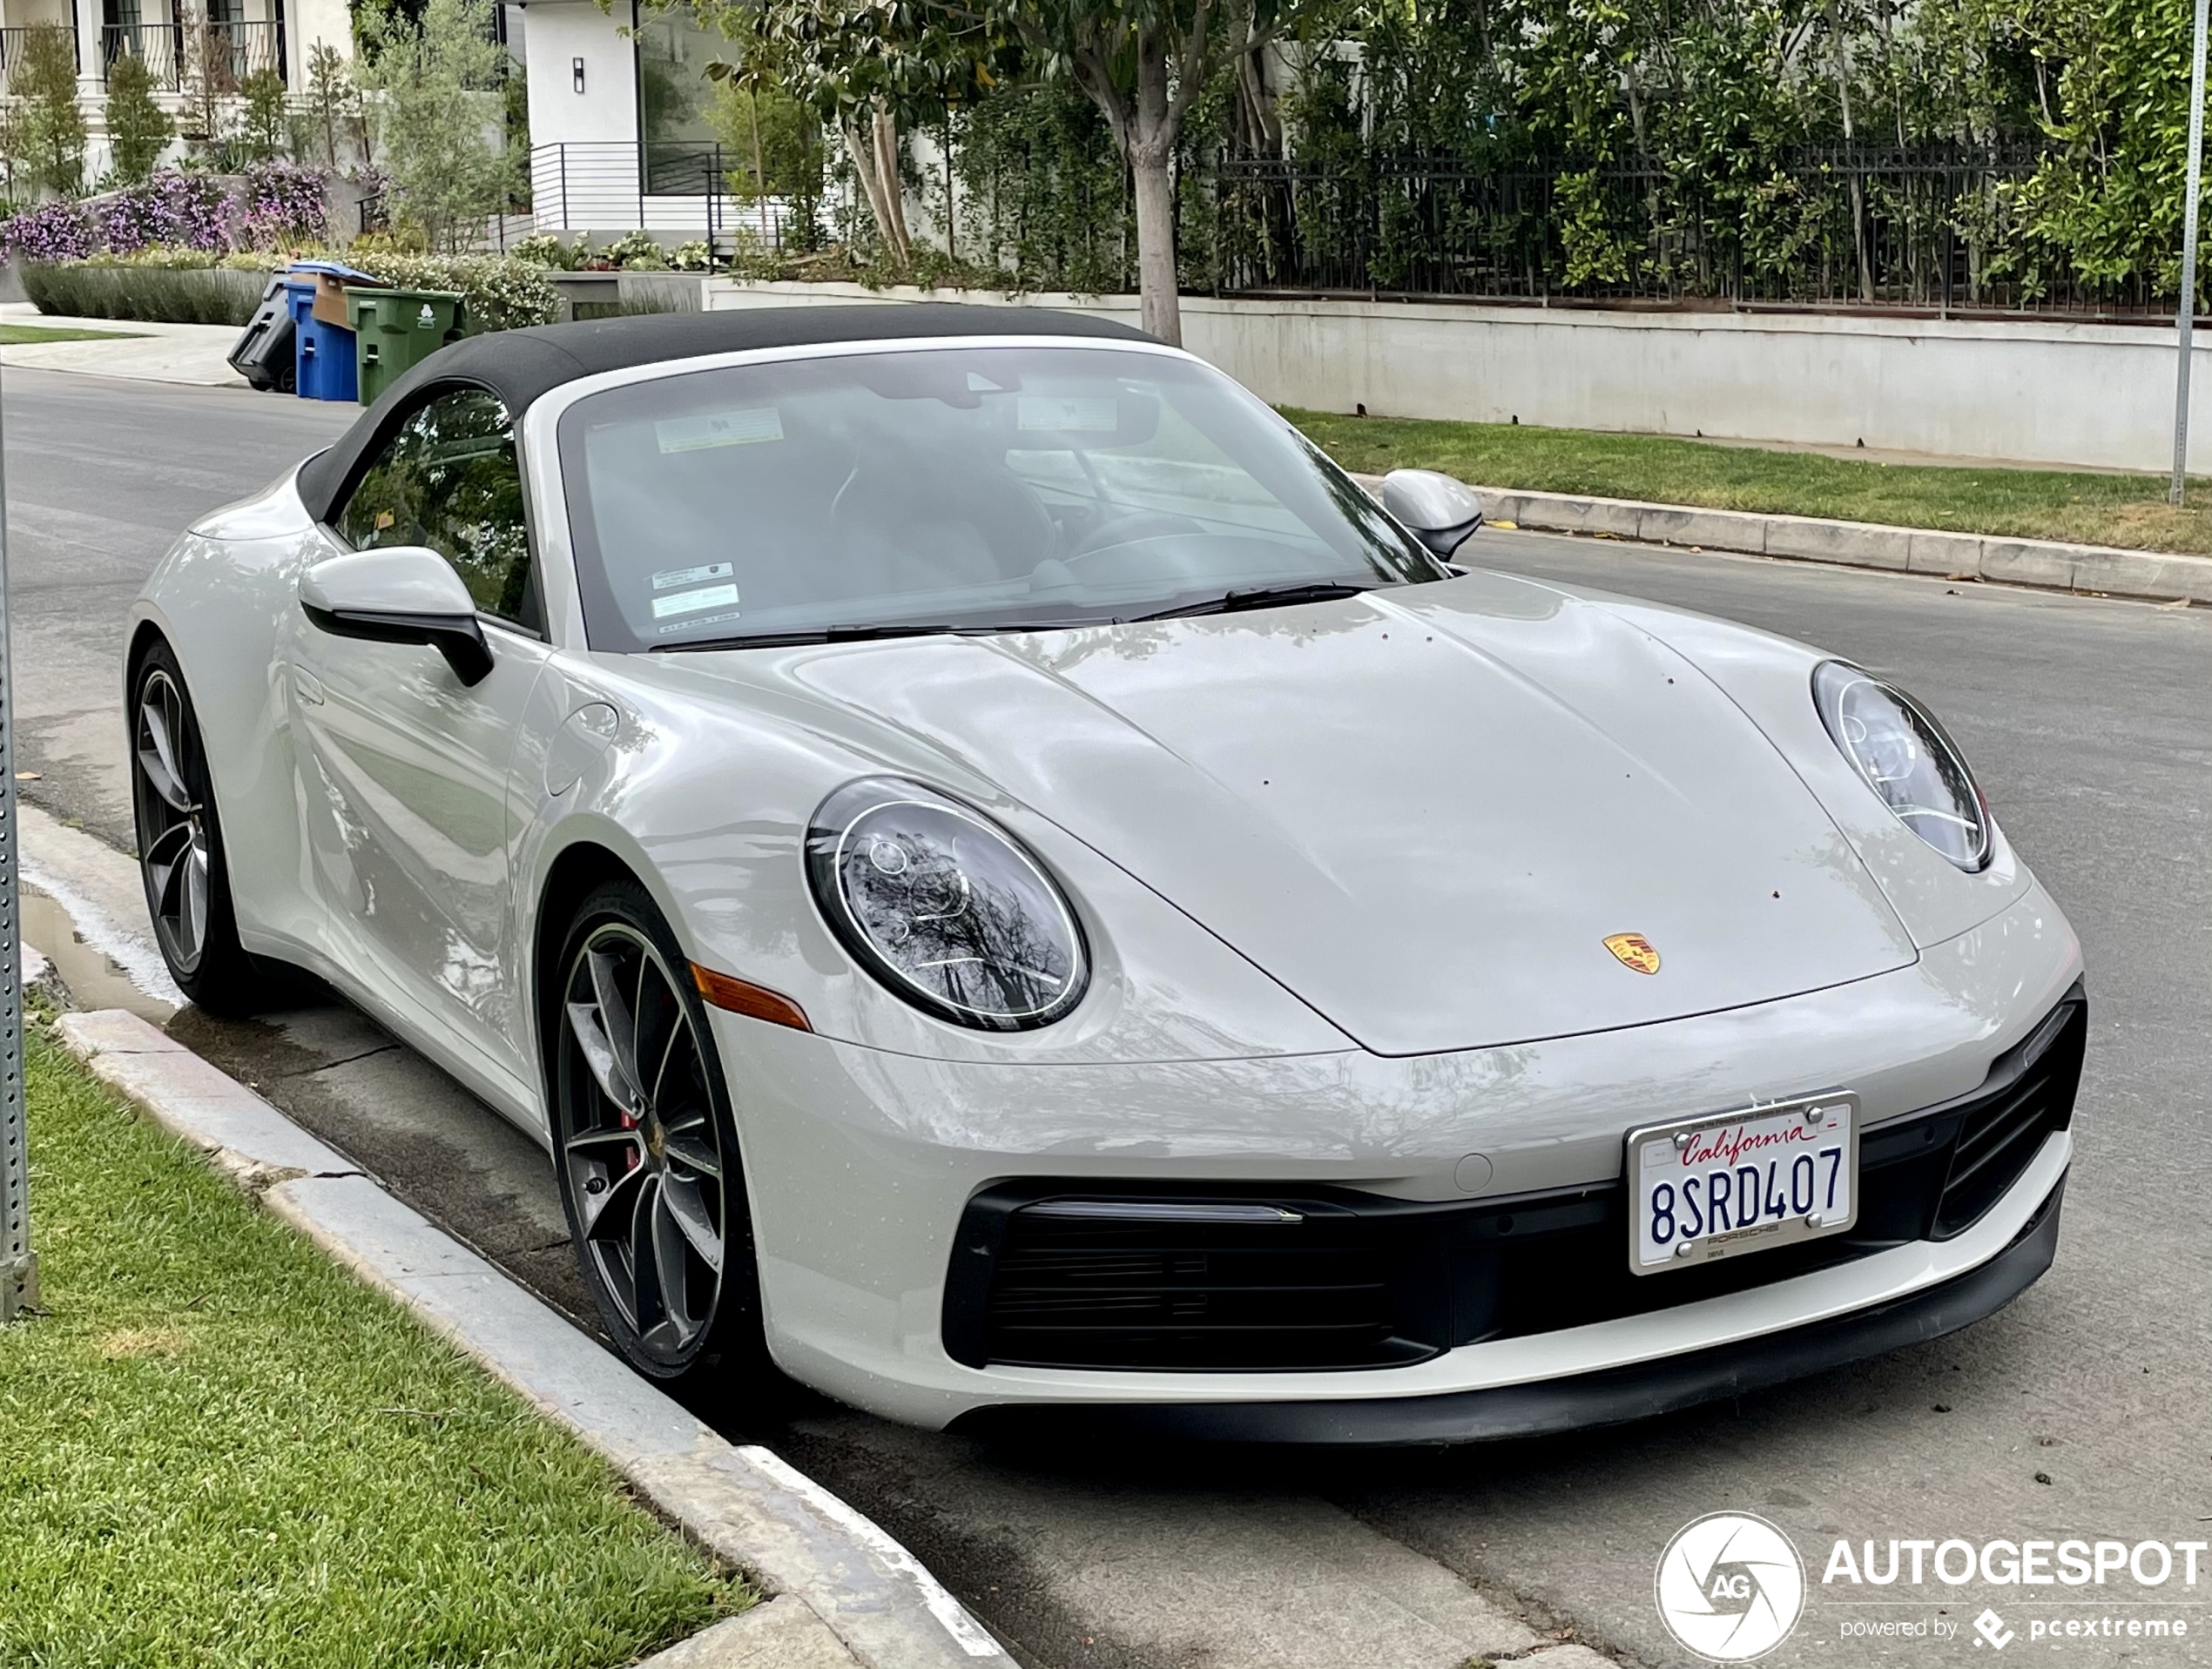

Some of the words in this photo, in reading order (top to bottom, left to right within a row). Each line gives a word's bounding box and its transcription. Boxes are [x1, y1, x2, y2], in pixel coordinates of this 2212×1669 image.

[1682, 1121, 1817, 1167] California
[1651, 1147, 1842, 1245] 8SRD407
[1707, 1224, 1779, 1245] PORSCHE
